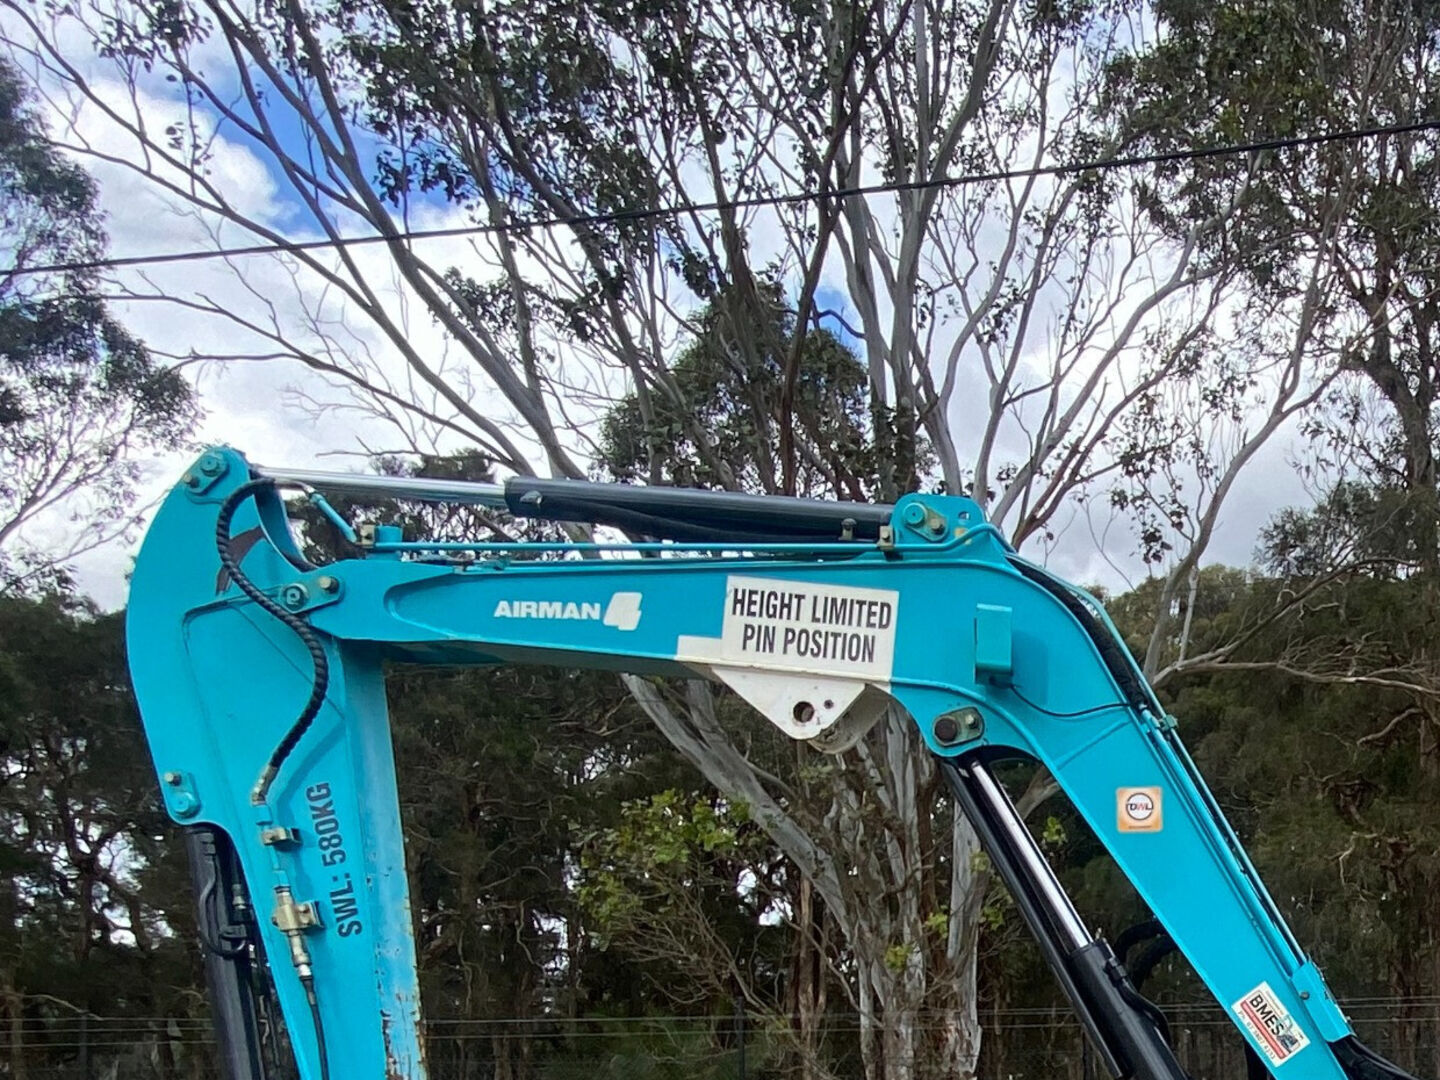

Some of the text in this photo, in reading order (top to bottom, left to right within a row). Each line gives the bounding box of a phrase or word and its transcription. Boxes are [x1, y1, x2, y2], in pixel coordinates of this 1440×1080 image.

[493, 600, 601, 621] AIRMAN
[732, 587, 893, 630] HEIGHT LIMITED
[742, 623, 876, 663] PIN POSITION
[305, 781, 363, 938] SWL: 580KG
[1249, 994, 1285, 1036] BMES
